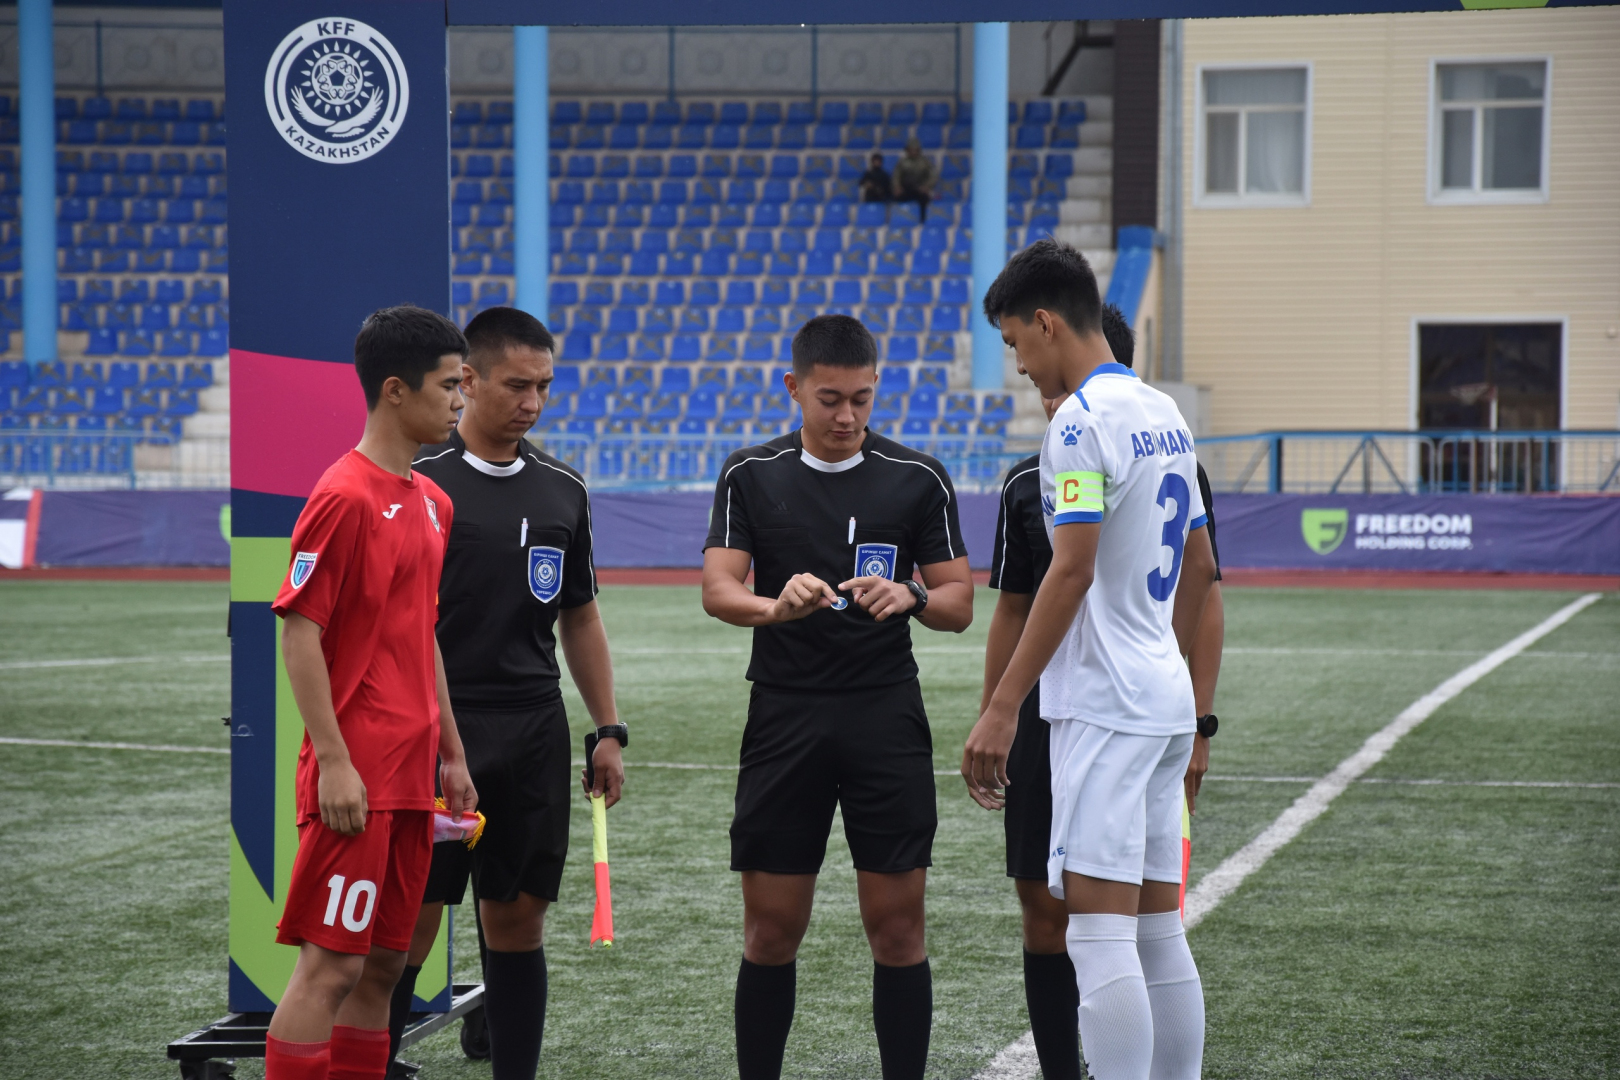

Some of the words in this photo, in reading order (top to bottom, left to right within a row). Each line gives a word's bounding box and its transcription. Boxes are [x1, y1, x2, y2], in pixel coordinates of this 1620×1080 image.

[317, 21, 356, 36] KFF
[285, 125, 390, 159] KAZAKHSTAN
[1063, 478, 1079, 503] C
[1146, 472, 1190, 602] 3
[1355, 513, 1473, 535] FREEDOM
[323, 874, 377, 933] 10
